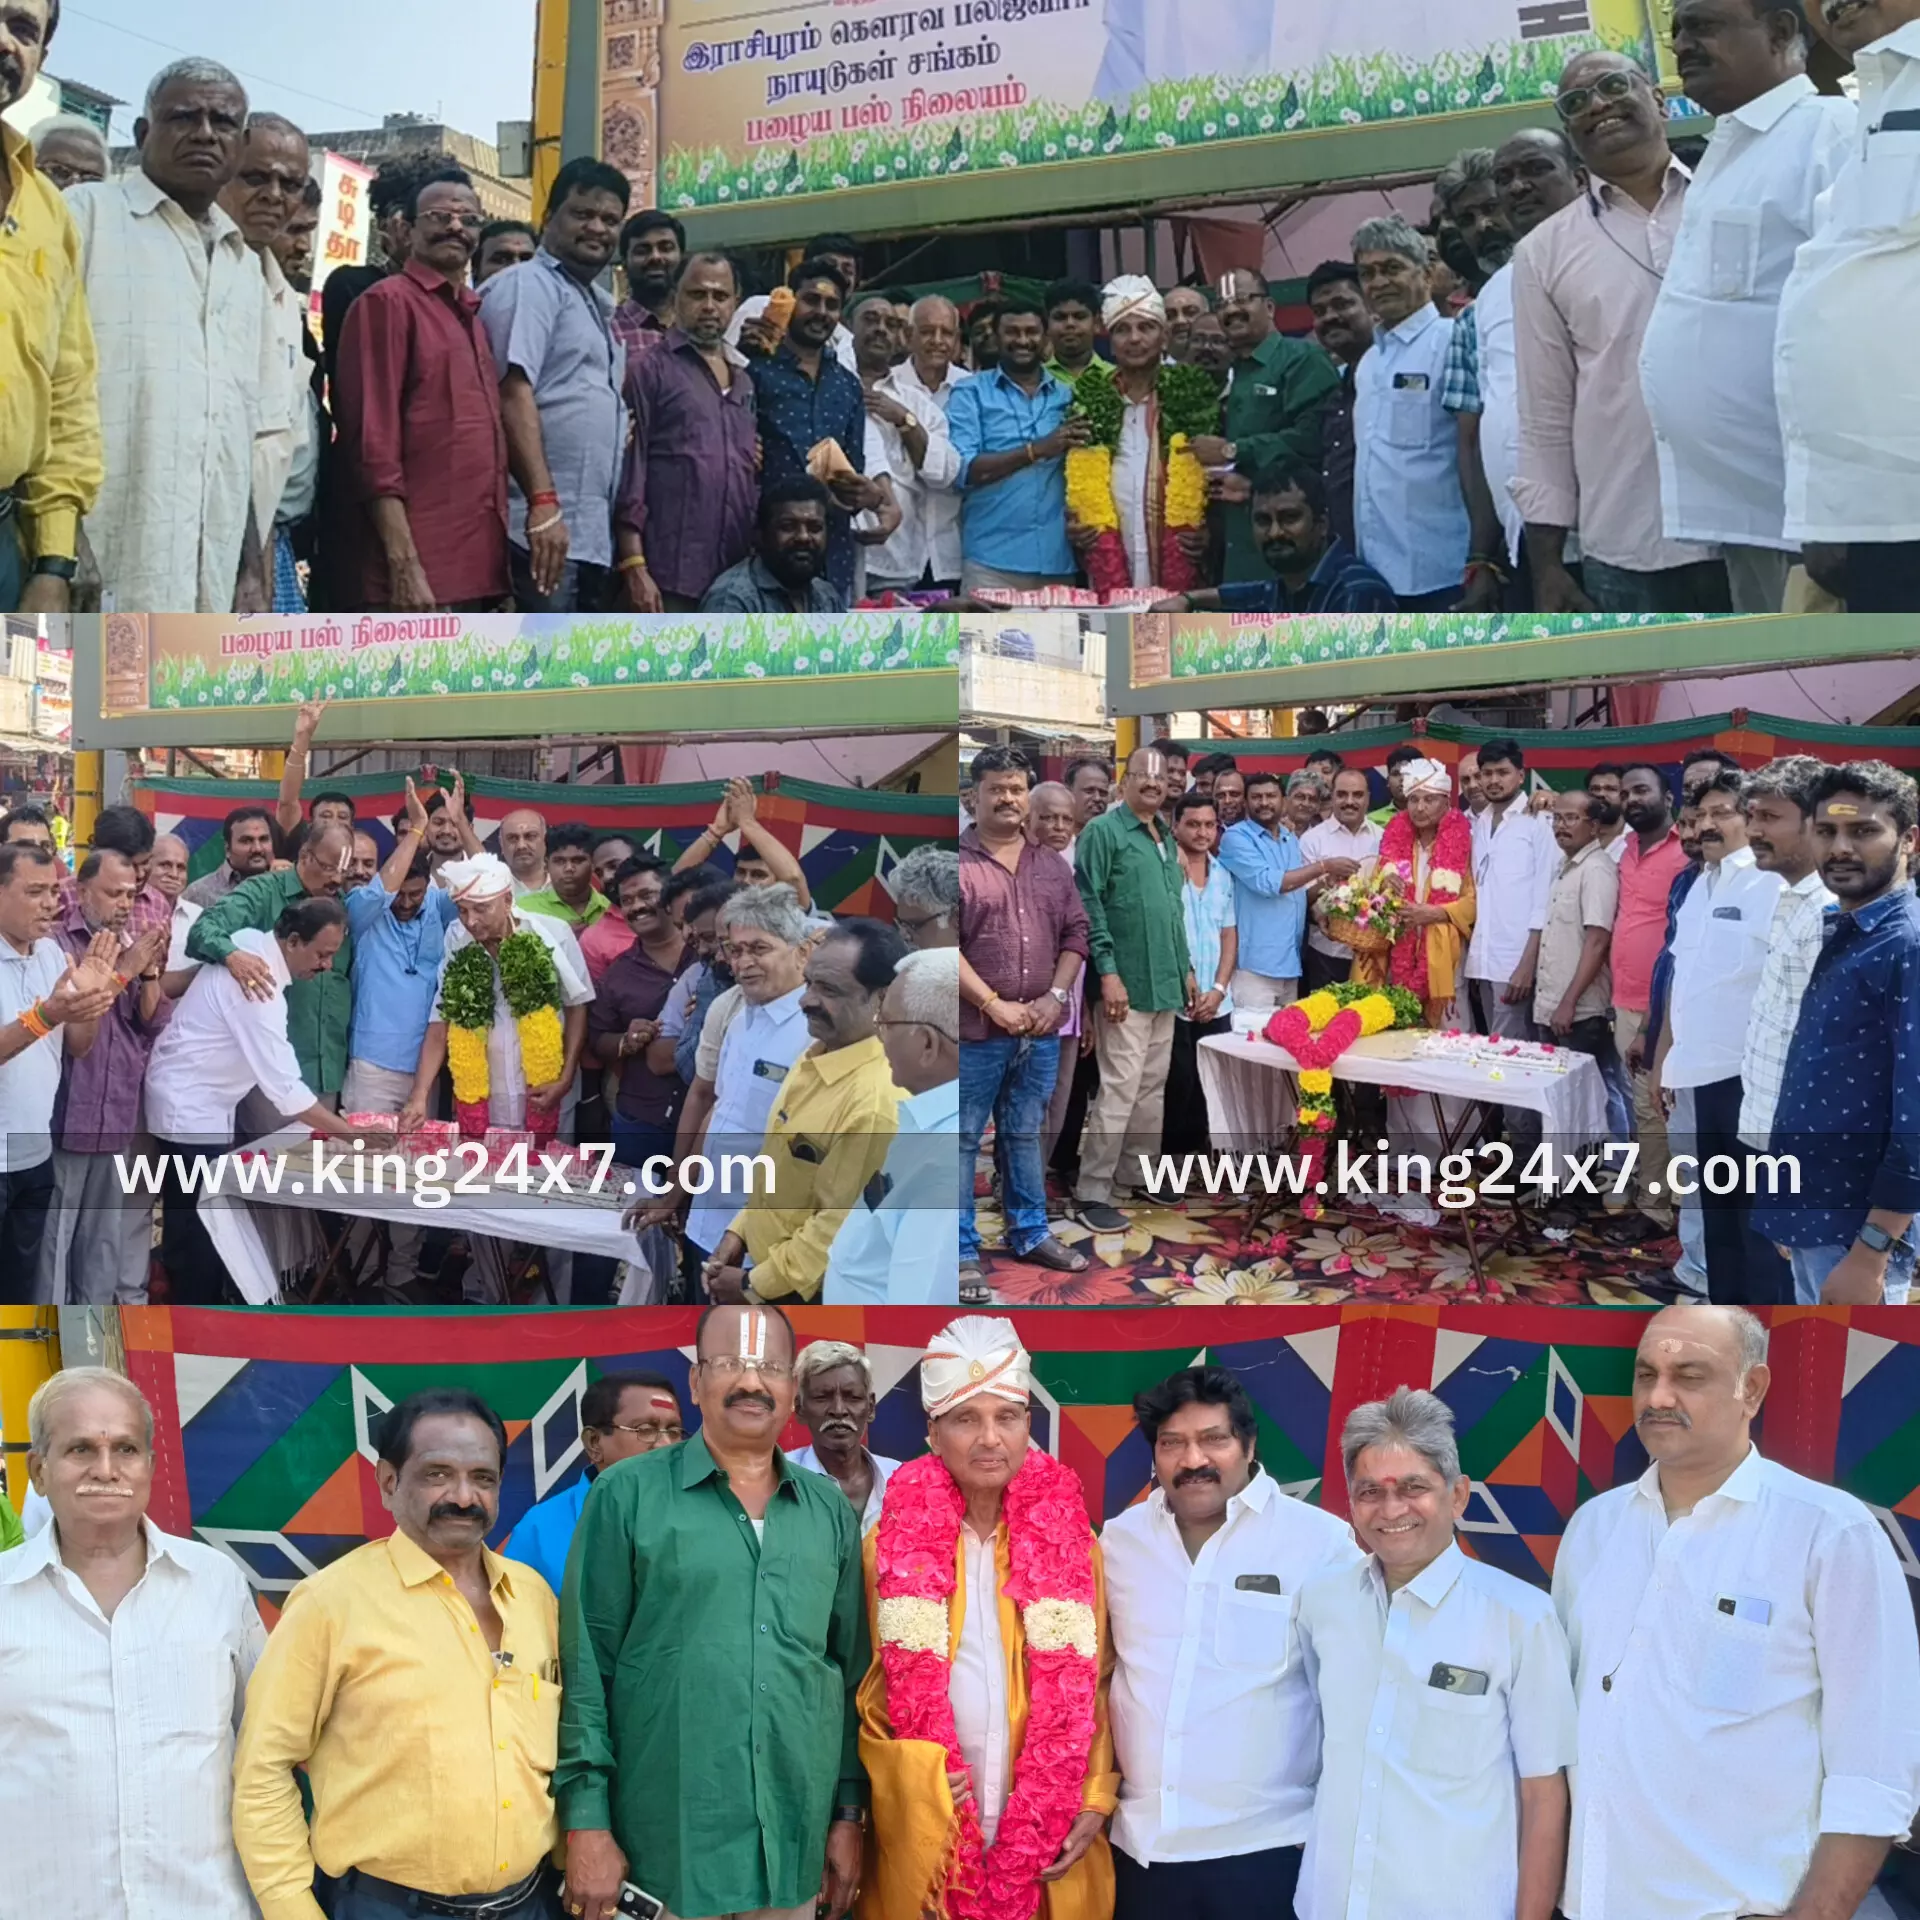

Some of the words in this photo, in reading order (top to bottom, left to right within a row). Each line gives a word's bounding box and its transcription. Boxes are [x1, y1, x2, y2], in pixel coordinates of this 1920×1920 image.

[683, 20, 822, 71] இராசிபுரம்
[830, 7, 945, 45] கௌரவ
[766, 50, 898, 105] நாயுடுகள்
[908, 34, 1001, 75] சங்கம்
[747, 109, 832, 144] பழைய
[842, 93, 892, 128] பஸ்
[902, 73, 1027, 126] நிலையம்
[221, 629, 292, 660] பழைய
[300, 618, 344, 648] பஸ்
